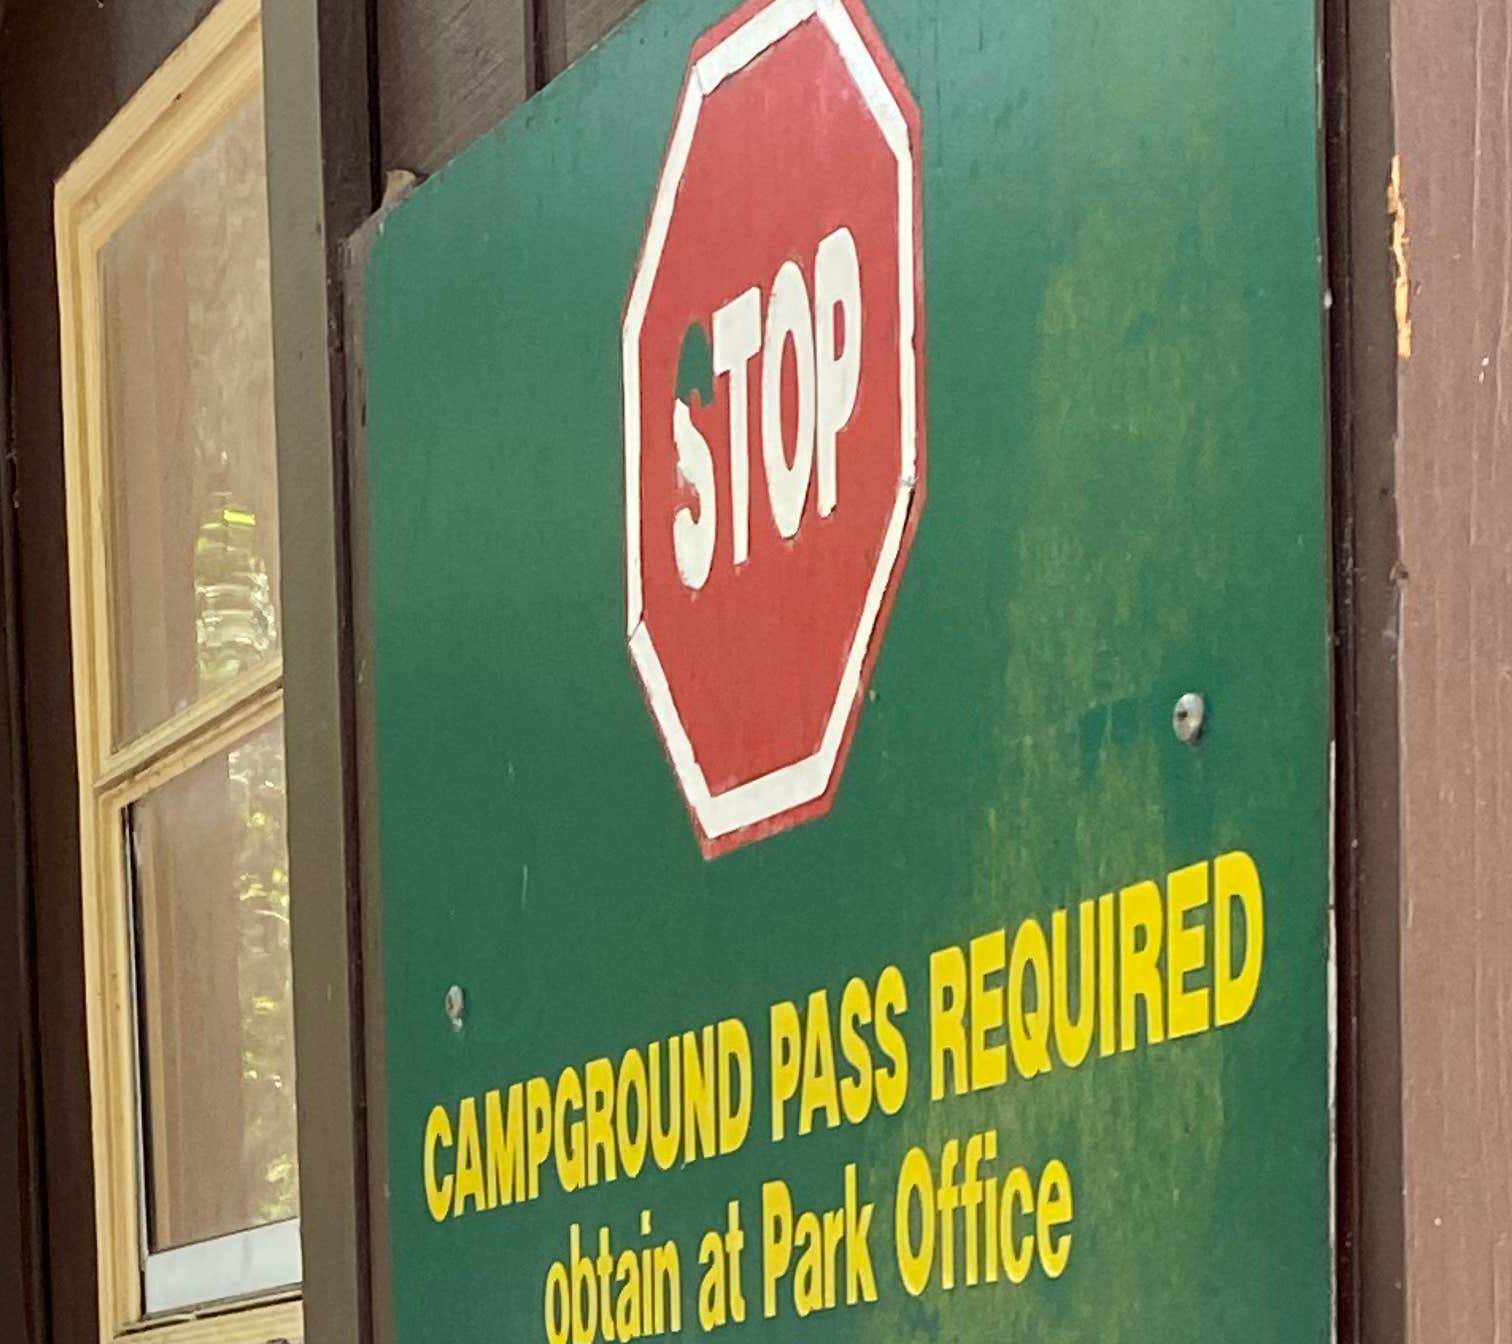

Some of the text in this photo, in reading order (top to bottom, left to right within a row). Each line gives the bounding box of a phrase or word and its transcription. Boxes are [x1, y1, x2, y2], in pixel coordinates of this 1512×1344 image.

[672, 226, 862, 592] STOP
[423, 850, 1265, 1222] CAMPGROUND PASS REQUIRED
[698, 1202, 746, 1331] at
[762, 1163, 879, 1318] Park
[895, 1130, 1074, 1297] Office
